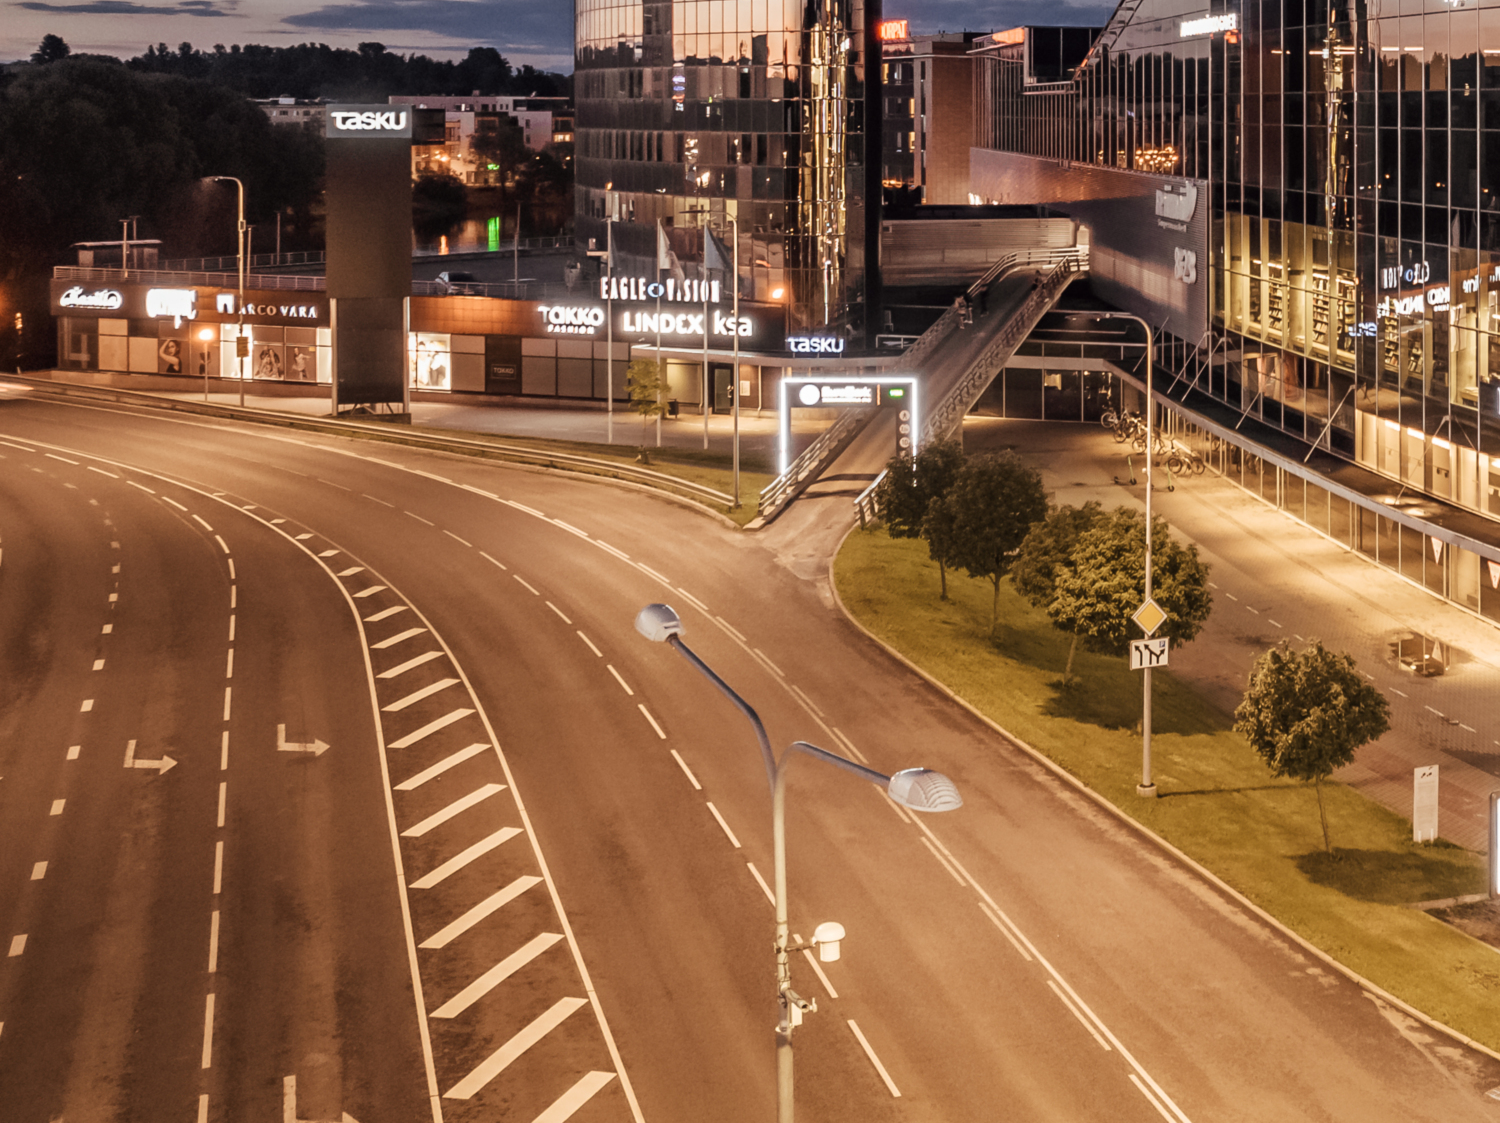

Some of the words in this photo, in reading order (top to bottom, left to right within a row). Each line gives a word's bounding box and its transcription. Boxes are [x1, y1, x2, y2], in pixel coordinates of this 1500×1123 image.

[880, 20, 908, 40] ORPAT
[600, 276, 646, 301] EAGLE
[666, 278, 720, 303] VISION
[280, 305, 317, 319] VARA
[547, 324, 595, 335] FASHION
[623, 311, 704, 335] LINDEX
